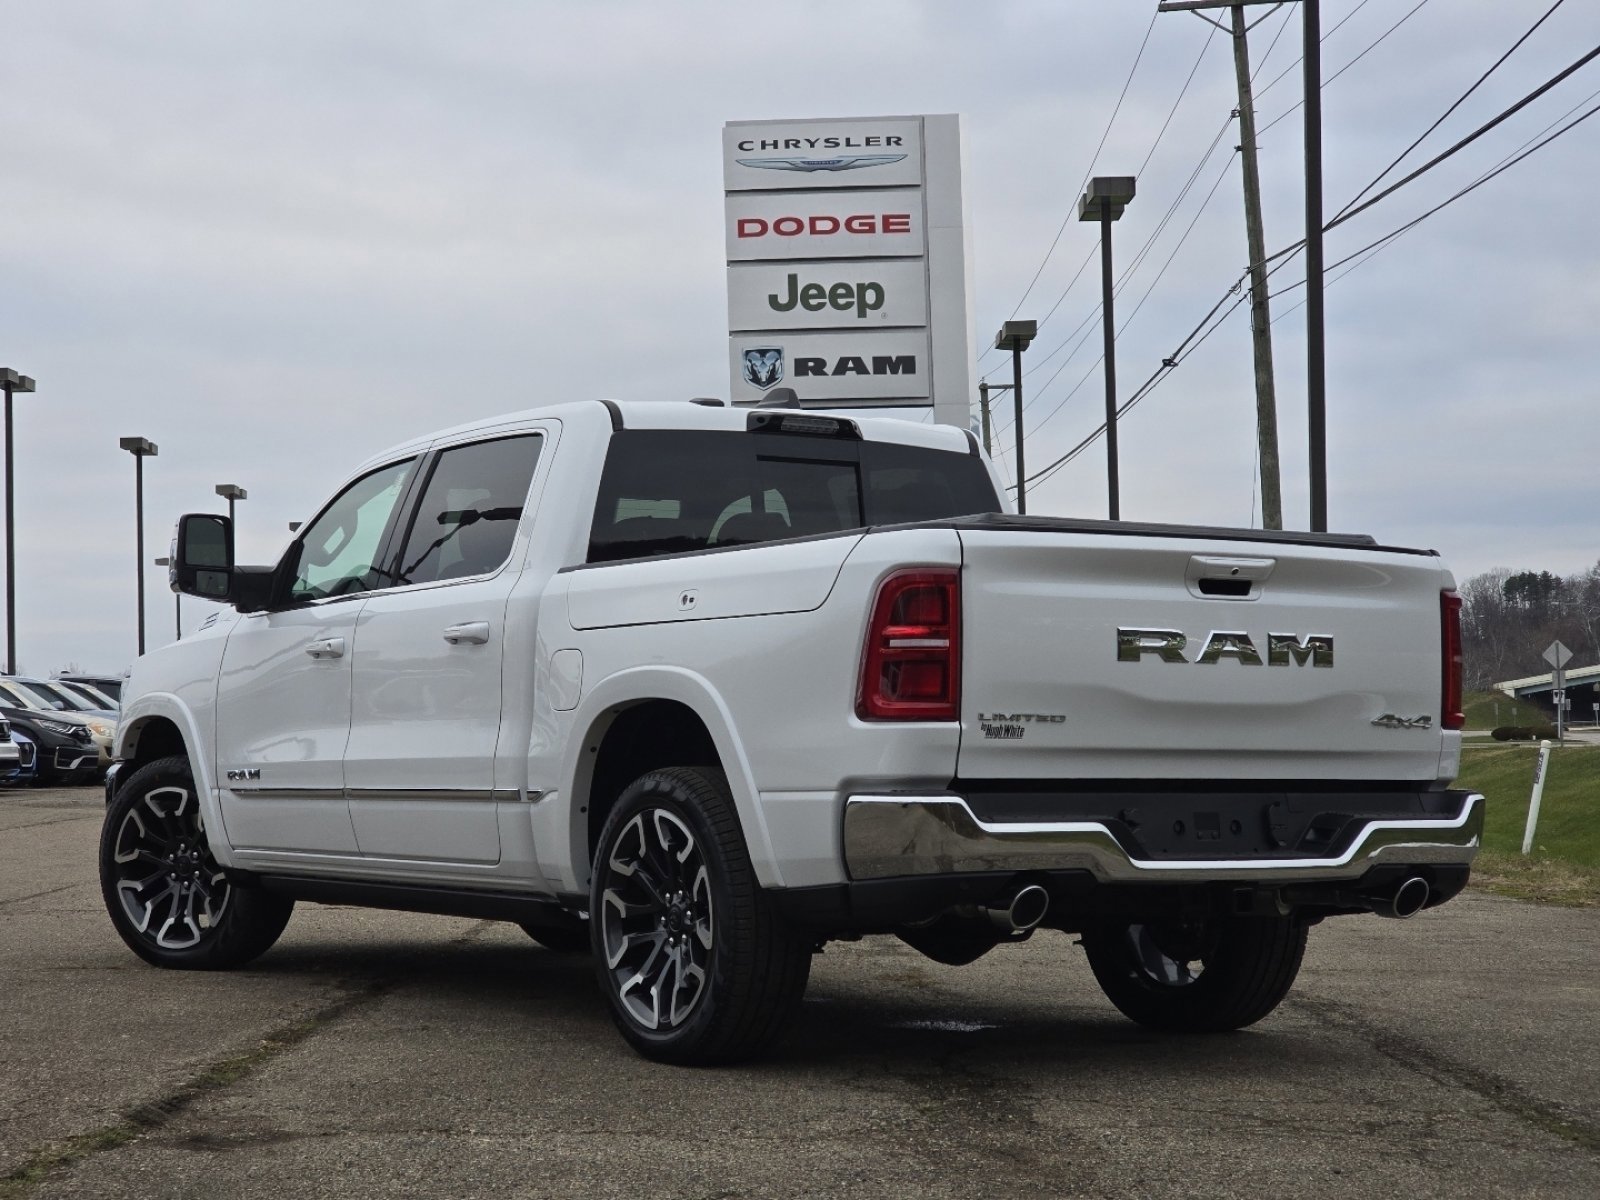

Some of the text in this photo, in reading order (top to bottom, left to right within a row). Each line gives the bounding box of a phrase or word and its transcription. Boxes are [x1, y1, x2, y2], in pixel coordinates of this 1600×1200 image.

[737, 136, 903, 152] CHRYSLER
[736, 214, 911, 238] DODGE
[768, 273, 885, 319] Jeep
[794, 355, 916, 377] RAM
[1116, 626, 1334, 668] RAM
[978, 713, 1066, 723] LIMITED
[985, 724, 1003, 739] Hugh
[1003, 724, 1025, 738] White
[227, 769, 261, 780] RAM
